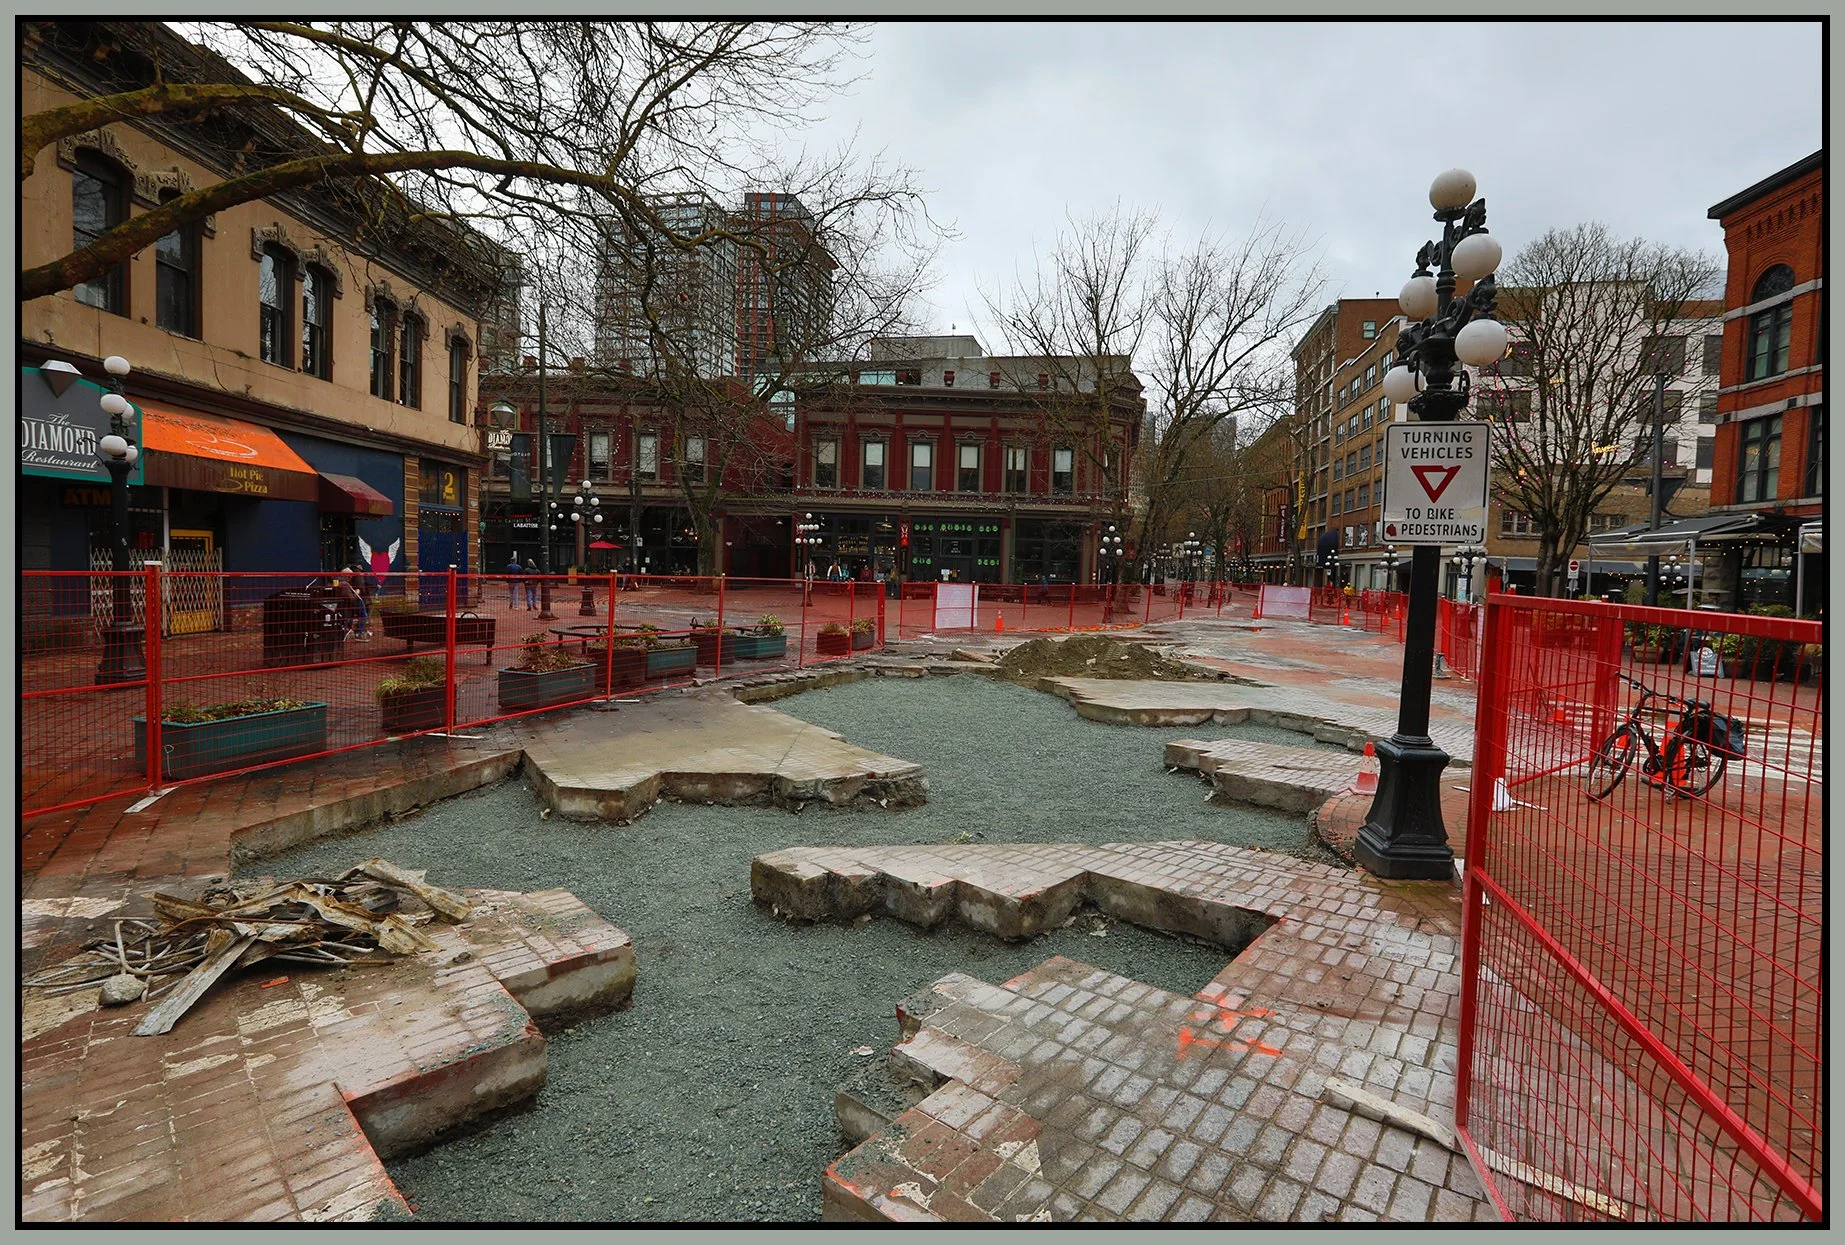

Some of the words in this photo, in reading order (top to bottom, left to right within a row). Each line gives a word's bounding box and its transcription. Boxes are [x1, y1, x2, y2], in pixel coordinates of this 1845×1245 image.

[46, 413, 71, 427] The
[22, 420, 97, 456] DIAMOND
[1403, 431, 1473, 444] TURNING
[22, 449, 98, 469] Restaurant
[1401, 446, 1473, 459] VEHICLES
[230, 467, 248, 479] Hot
[249, 470, 264, 481] Pie
[244, 481, 268, 494] Pizza
[444, 472, 454, 494] 2
[63, 487, 112, 505] ATM
[1405, 508, 1421, 520] TO
[1427, 508, 1455, 520] BIKE
[1401, 523, 1478, 537] PEDESTRIANS
